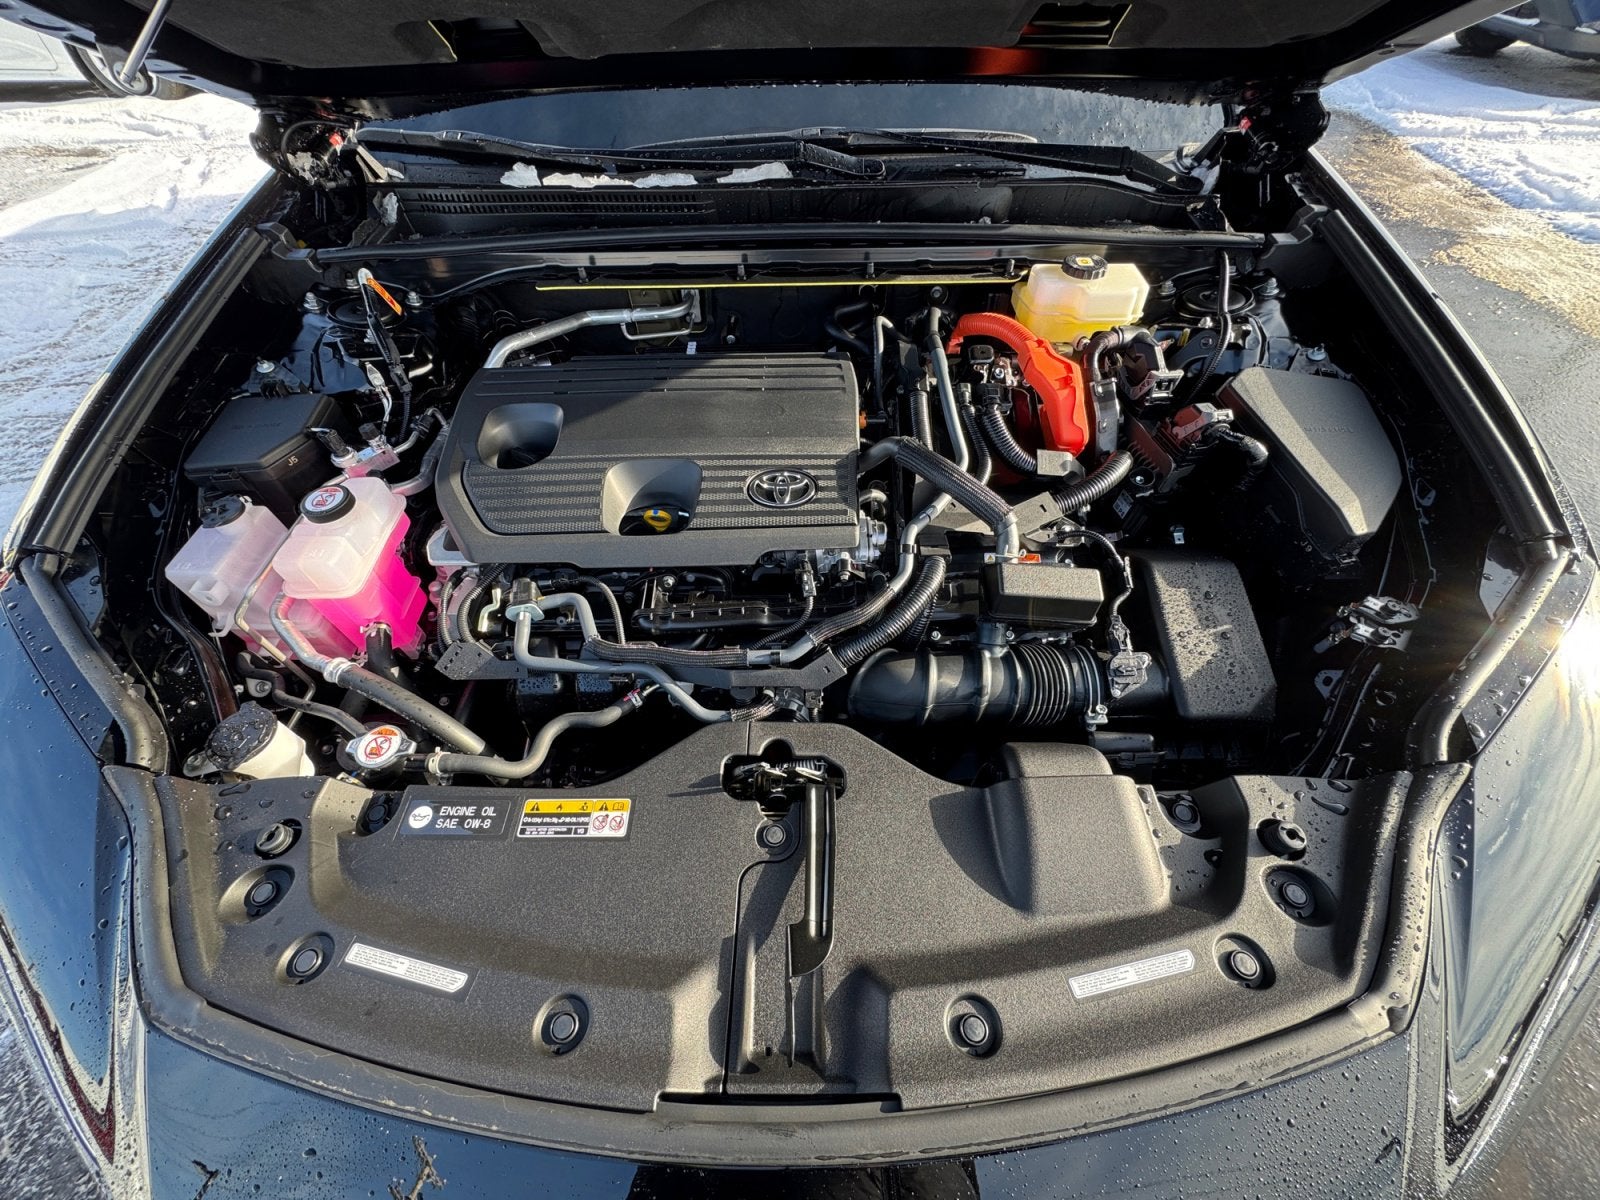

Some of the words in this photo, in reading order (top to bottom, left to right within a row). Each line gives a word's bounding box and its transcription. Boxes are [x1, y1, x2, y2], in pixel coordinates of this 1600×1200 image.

[439, 806, 477, 816] ENGINE
[481, 806, 497, 816] OIL
[435, 818, 459, 829] SAE
[464, 818, 492, 829] 0W-8
